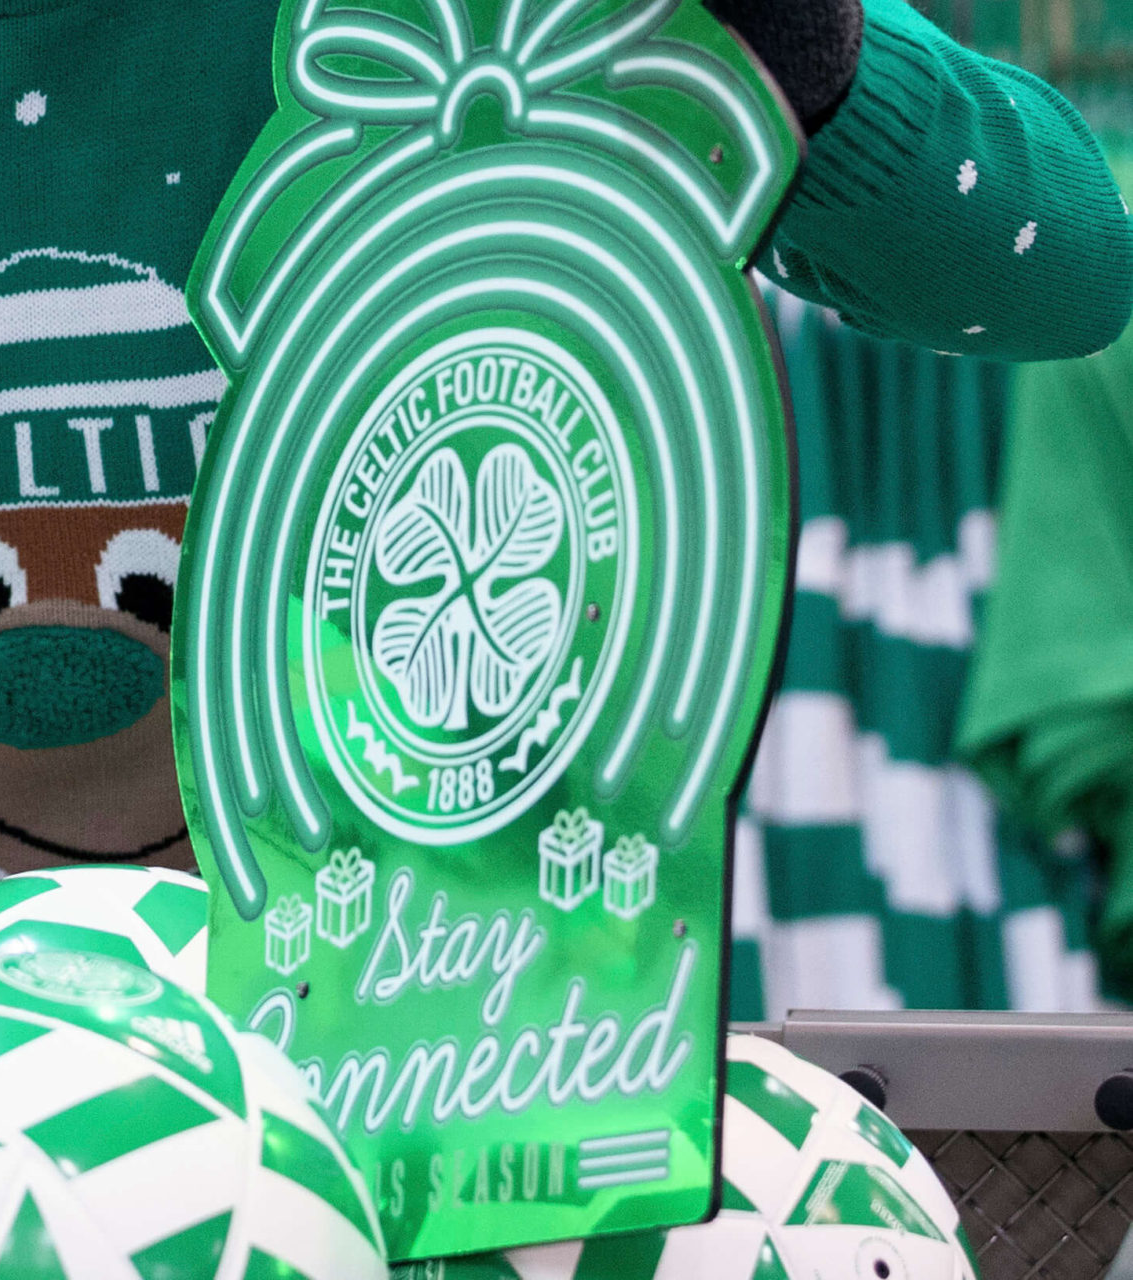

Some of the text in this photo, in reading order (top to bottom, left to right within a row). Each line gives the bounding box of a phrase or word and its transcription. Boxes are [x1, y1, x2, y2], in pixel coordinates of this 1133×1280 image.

[320, 357, 618, 620] THE CELTIC FOOTBALL CLUB
[427, 761, 494, 812] 1888
[357, 870, 544, 1026] Stay
[249, 944, 692, 1132] nnected
[428, 1142, 565, 1212] SEASON
